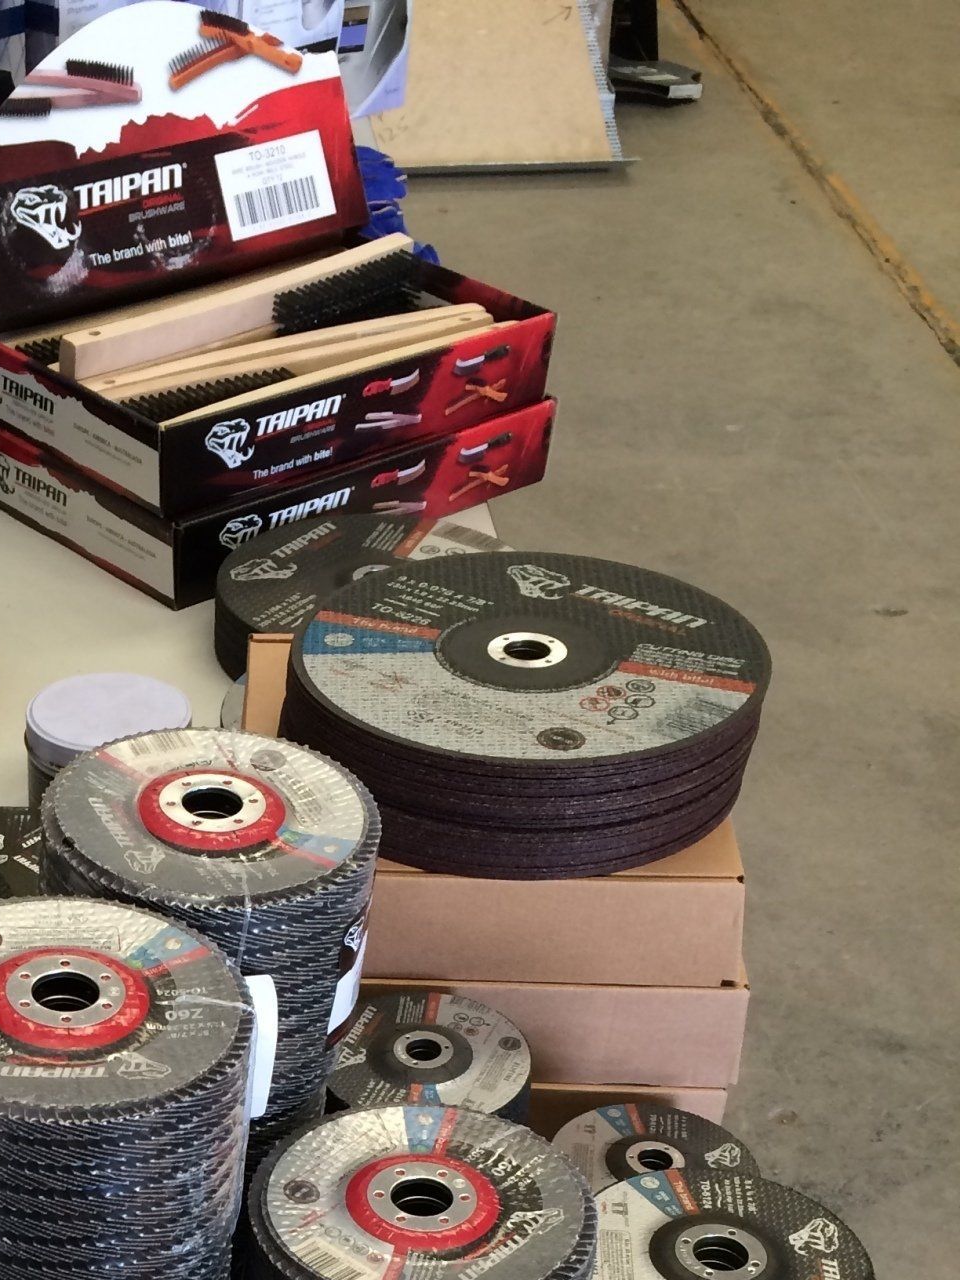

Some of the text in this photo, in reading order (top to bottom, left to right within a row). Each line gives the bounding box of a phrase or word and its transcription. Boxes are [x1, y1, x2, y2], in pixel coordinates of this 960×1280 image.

[73, 163, 184, 210] TAIPAN
[128, 201, 186, 224] BRUSHWARE
[90, 230, 193, 267] The brand with bite!
[1, 376, 55, 416] TAIPAN
[255, 394, 342, 437] TAIPAN
[289, 425, 335, 444] BRUSHWARE
[252, 446, 334, 480] The brand with bite!
[14, 466, 68, 507] TAIPAN
[268, 487, 352, 529] TAIPAN
[270, 521, 338, 559] TAIPAN
[575, 584, 707, 629] TAIPAN
[345, 1005, 377, 1045] TAIPAN
[0, 1064, 105, 1079] TAIPAN
